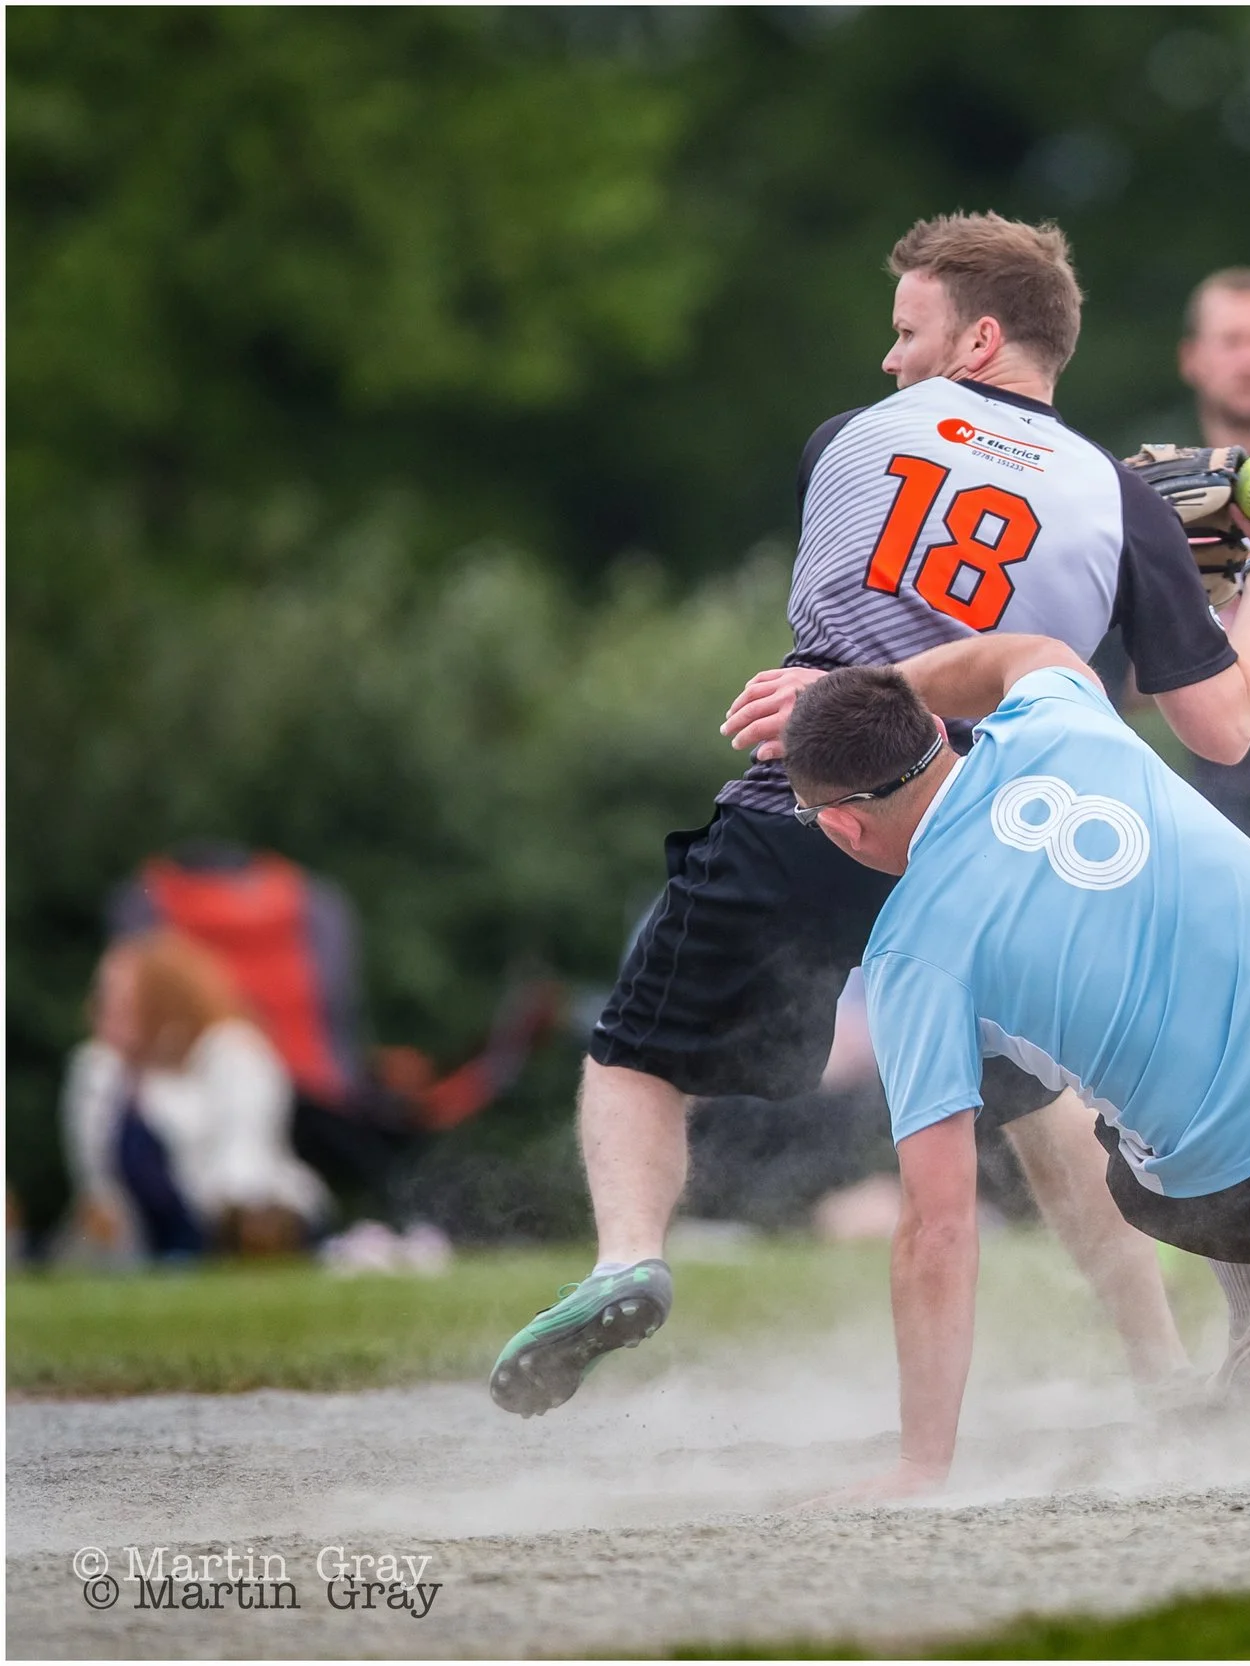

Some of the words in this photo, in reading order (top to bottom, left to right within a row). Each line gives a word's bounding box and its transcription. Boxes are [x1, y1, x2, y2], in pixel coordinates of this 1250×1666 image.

[956, 427, 973, 438] N
[862, 454, 1042, 633] 18
[990, 774, 1150, 891] 8
